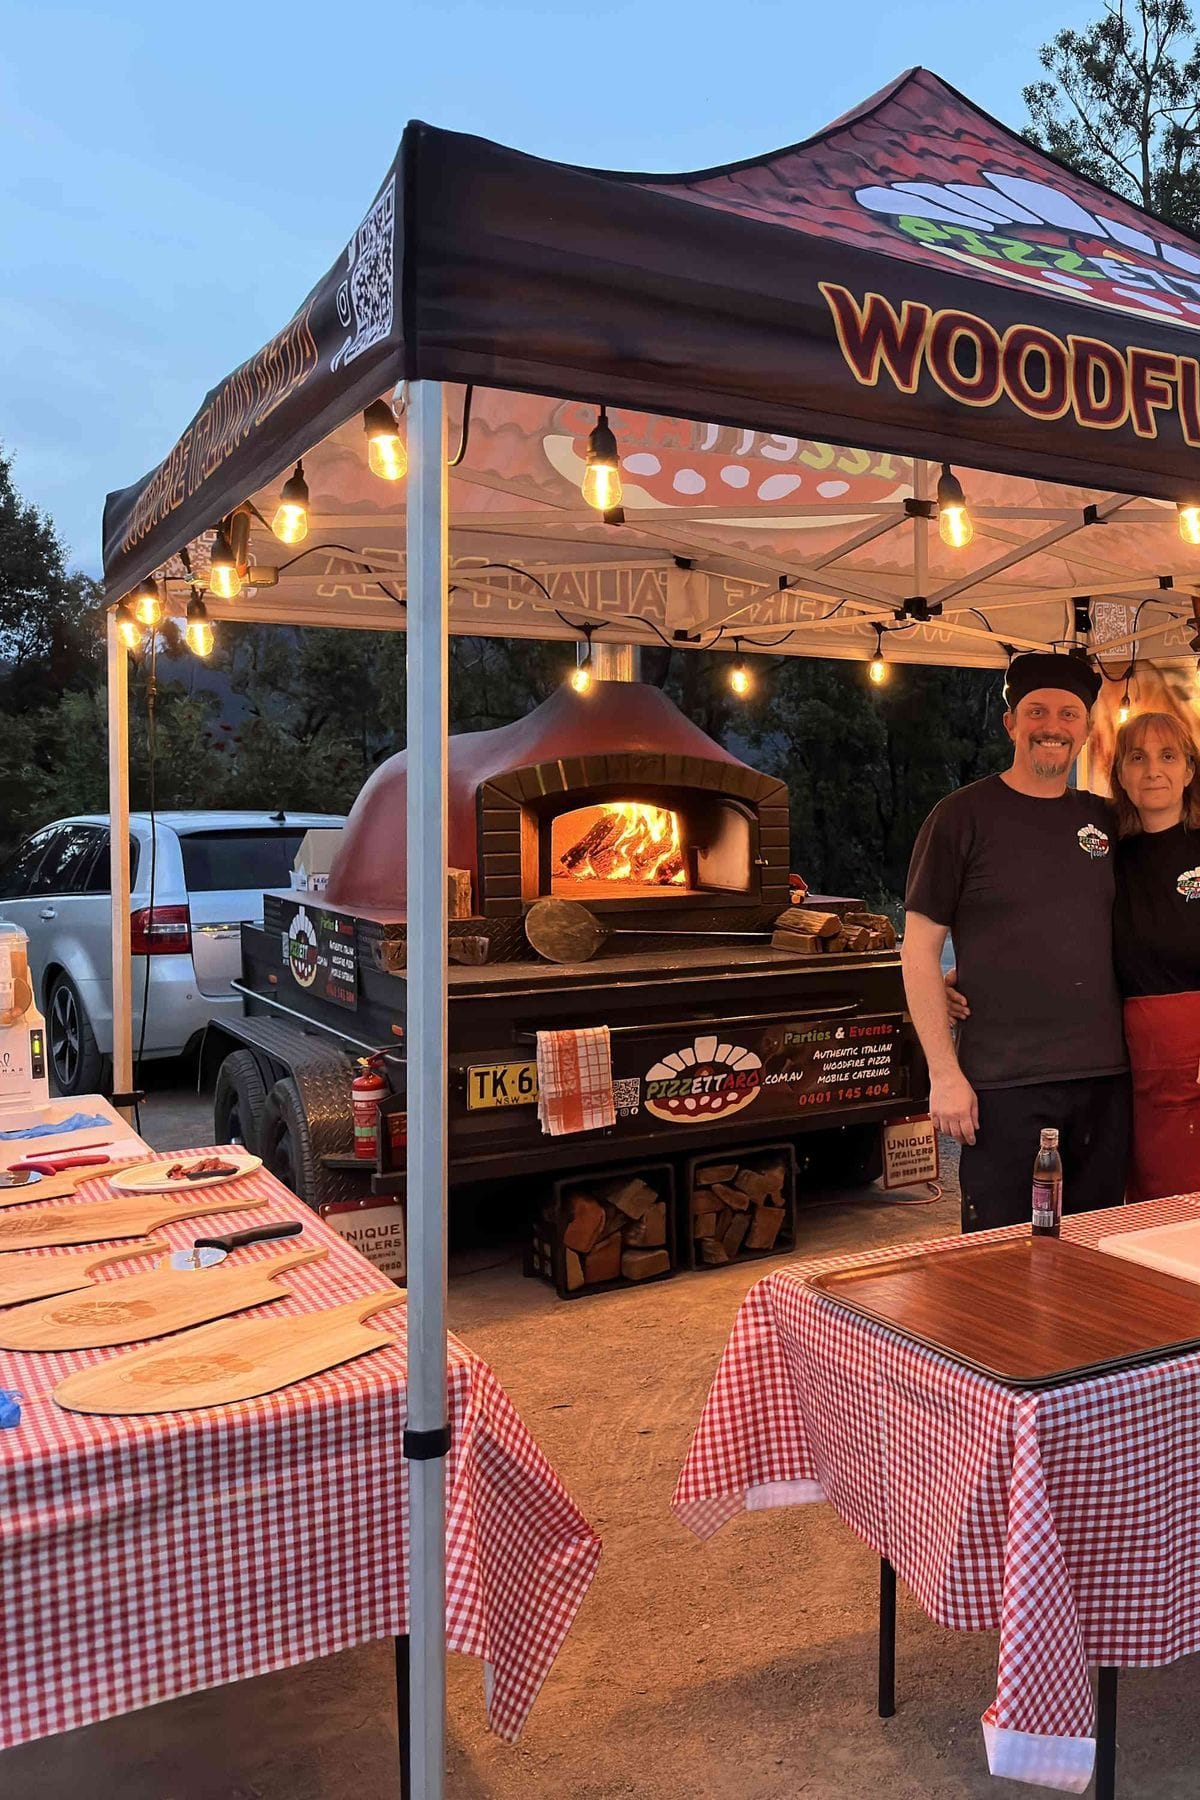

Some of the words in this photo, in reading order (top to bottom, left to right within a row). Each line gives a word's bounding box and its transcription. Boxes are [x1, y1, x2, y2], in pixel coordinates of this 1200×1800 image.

[784, 1030, 831, 1044] Parties
[835, 1027, 845, 1039] &
[849, 1024, 893, 1037] Events
[813, 1046, 858, 1060] AUTHENTIC
[861, 1043, 893, 1055] ITALIAN
[822, 1058, 865, 1071] WOODFIRE
[867, 1056, 891, 1067] PIZZA
[817, 1072, 850, 1084] MOBILE
[852, 1068, 890, 1080] CATERING
[799, 1091, 831, 1106] 0401
[838, 1087, 861, 1100] 145
[865, 1083, 890, 1096] 404
[887, 1135, 933, 1150] UNIQUE
[887, 1147, 934, 1160] TRAILERS
[340, 1223, 400, 1241] NIQUE
[354, 1238, 401, 1252] AILERS
